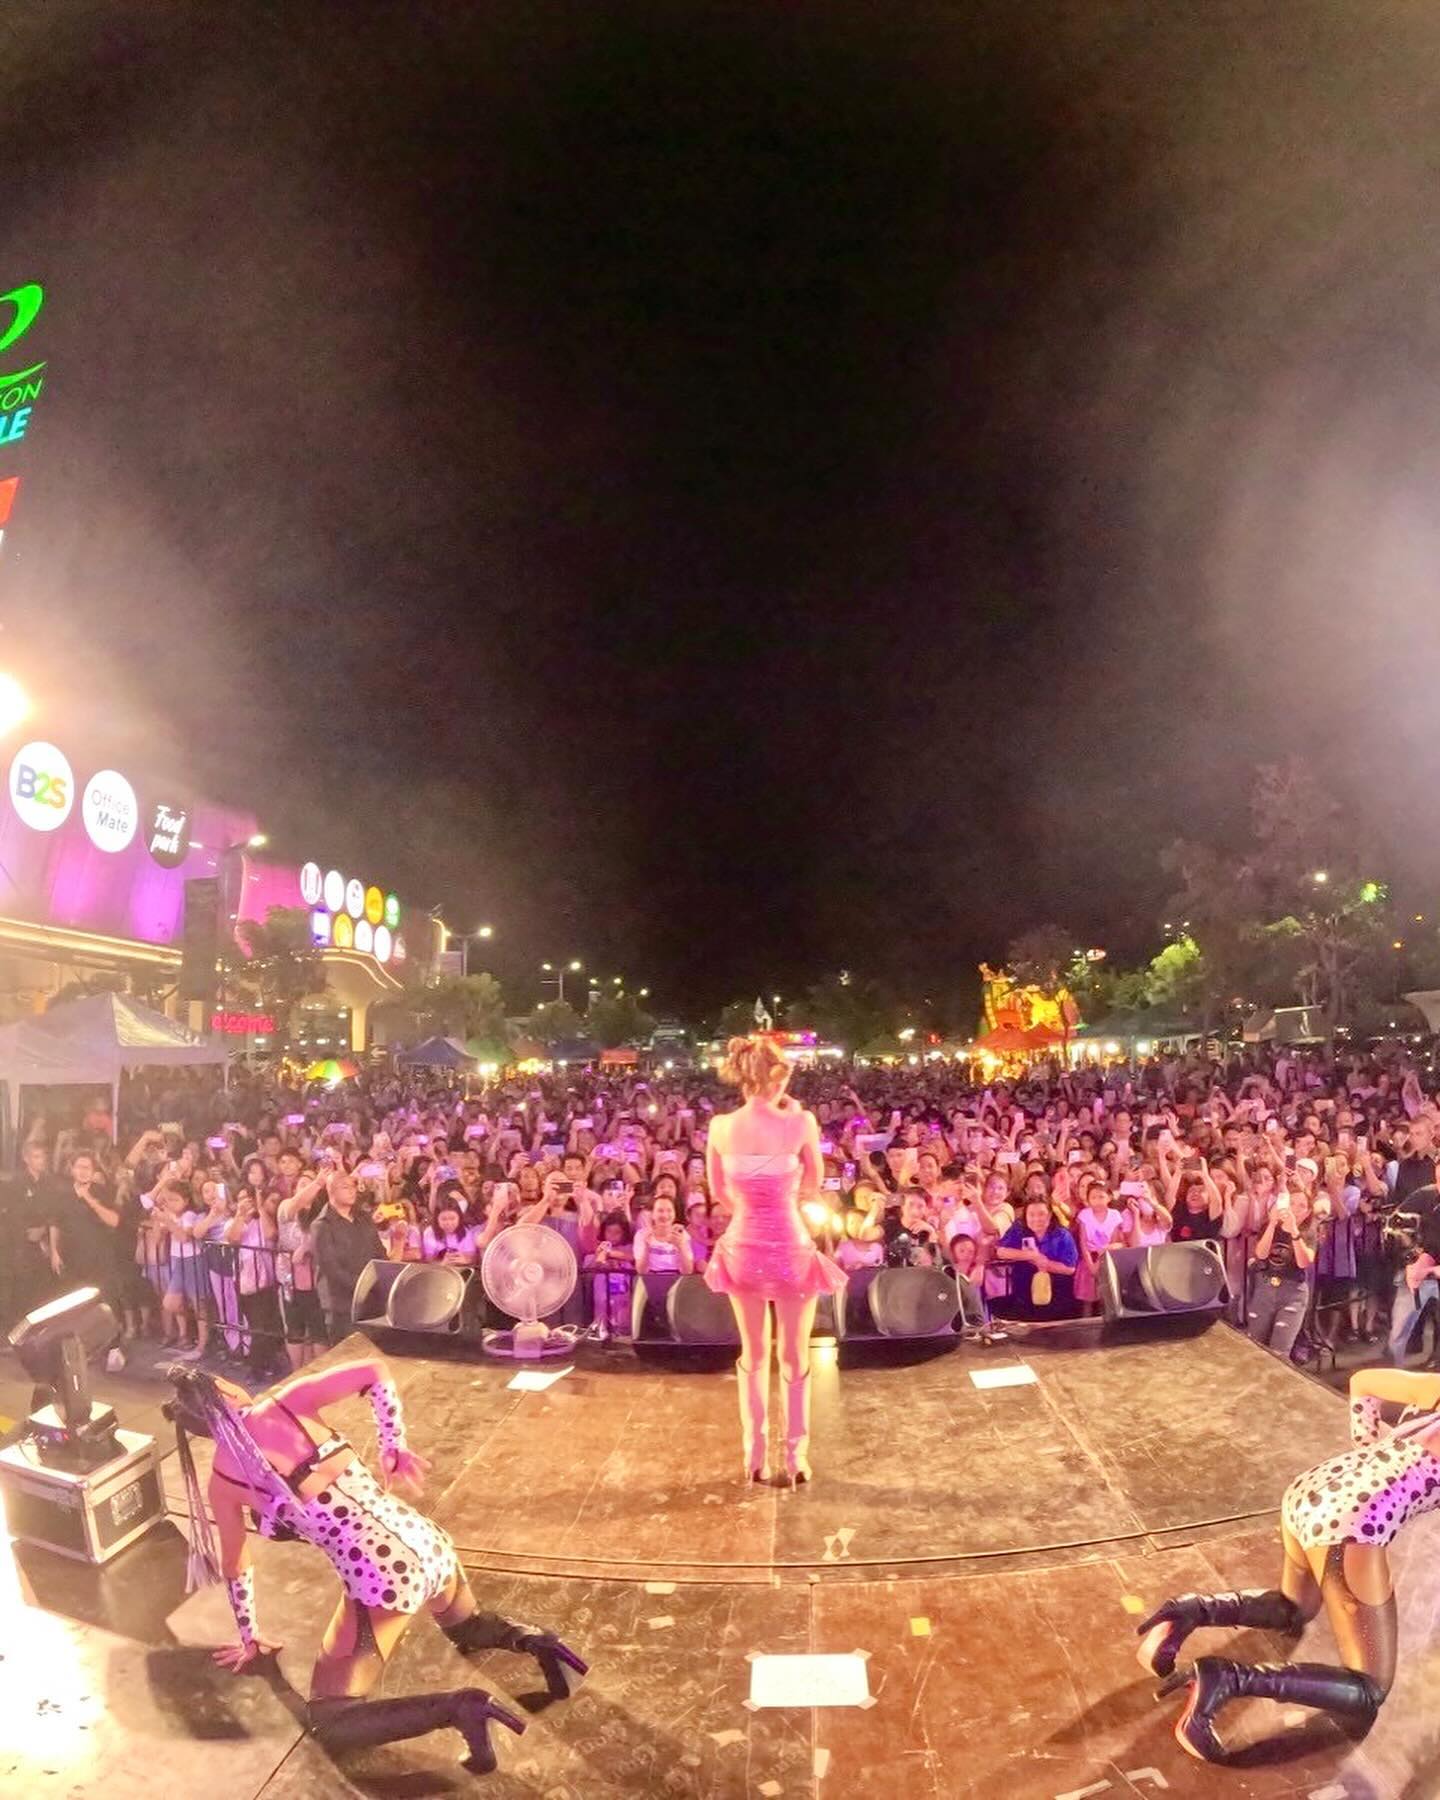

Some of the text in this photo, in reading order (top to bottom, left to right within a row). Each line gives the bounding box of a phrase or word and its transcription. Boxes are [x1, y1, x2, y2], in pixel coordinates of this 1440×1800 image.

[0, 377, 43, 411] ON
[16, 764, 67, 809] B2S
[91, 789, 130, 816] Office
[96, 811, 129, 833] Mate
